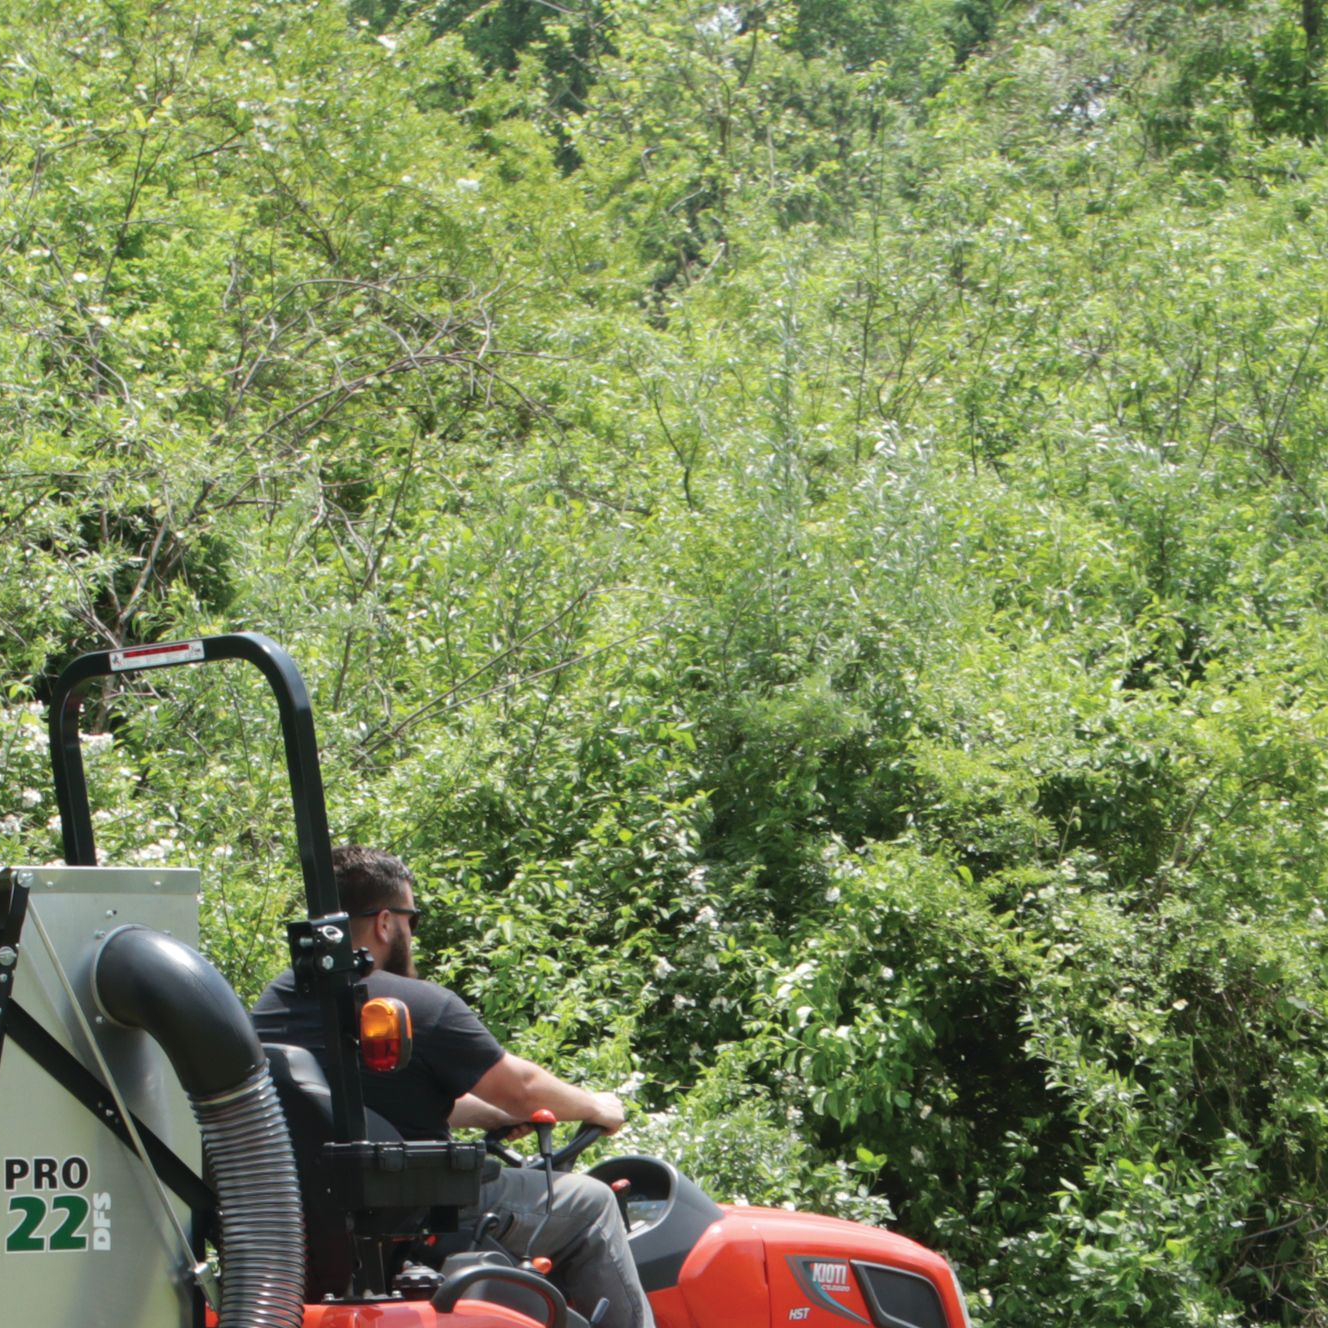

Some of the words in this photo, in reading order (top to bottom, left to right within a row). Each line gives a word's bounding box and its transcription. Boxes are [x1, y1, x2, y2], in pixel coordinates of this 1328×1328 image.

[4, 1156, 90, 1191] PRO
[5, 1194, 89, 1253] 22
[92, 1192, 112, 1251] DFS
[812, 1262, 848, 1285] KIOTI
[789, 1307, 811, 1321] HST
